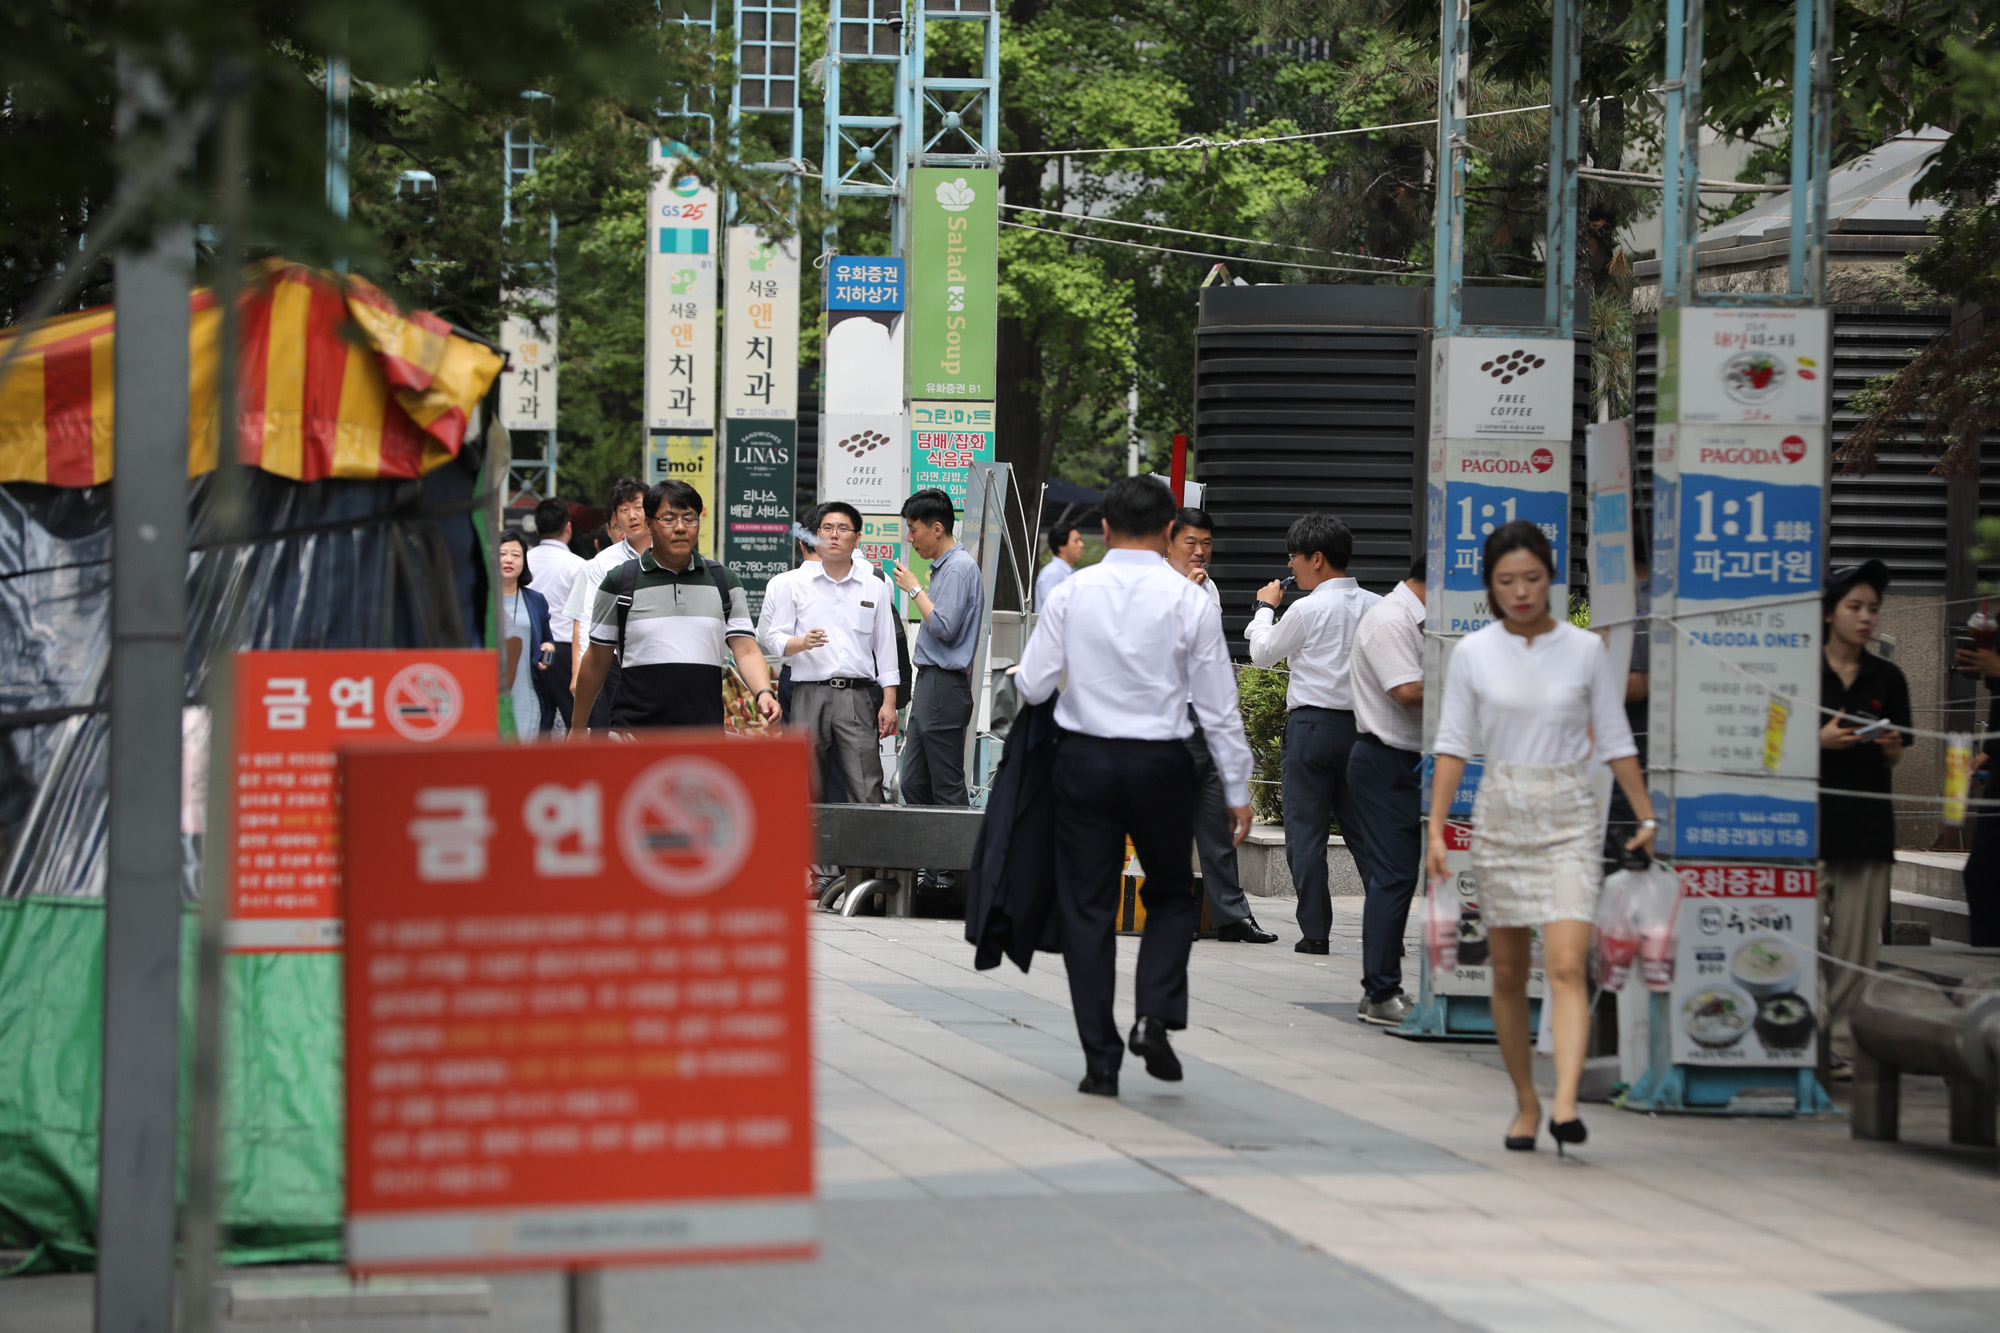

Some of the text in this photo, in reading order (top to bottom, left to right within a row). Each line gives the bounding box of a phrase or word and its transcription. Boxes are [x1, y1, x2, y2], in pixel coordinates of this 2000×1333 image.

[947, 216, 967, 282] Salad
[836, 265, 898, 283] 유화증권
[836, 286, 899, 303] 지하상가
[941, 316, 965, 375] Soup
[926, 382, 981, 394] 유화증권 B1
[1498, 394, 1526, 404] FREE
[915, 409, 991, 425] 그린마트
[1490, 407, 1533, 416] COFFEE
[917, 432, 986, 450] 담배/잡화
[927, 451, 974, 468] 식음료
[1461, 455, 1552, 473] PAGODA ONE
[1700, 448, 1781, 464] PAGODA
[853, 466, 877, 474] FREE
[846, 477, 883, 486] COFFEE
[743, 489, 777, 502] 리나스
[730, 504, 790, 518] 배달 서비스
[1694, 491, 1768, 542] 1:1
[729, 561, 788, 572] 02-780-5178
[1692, 549, 1812, 583] 파고다원
[1713, 612, 1786, 628] WHAT IS
[1764, 633, 1811, 648] ONE?
[1783, 870, 1811, 893] B1
